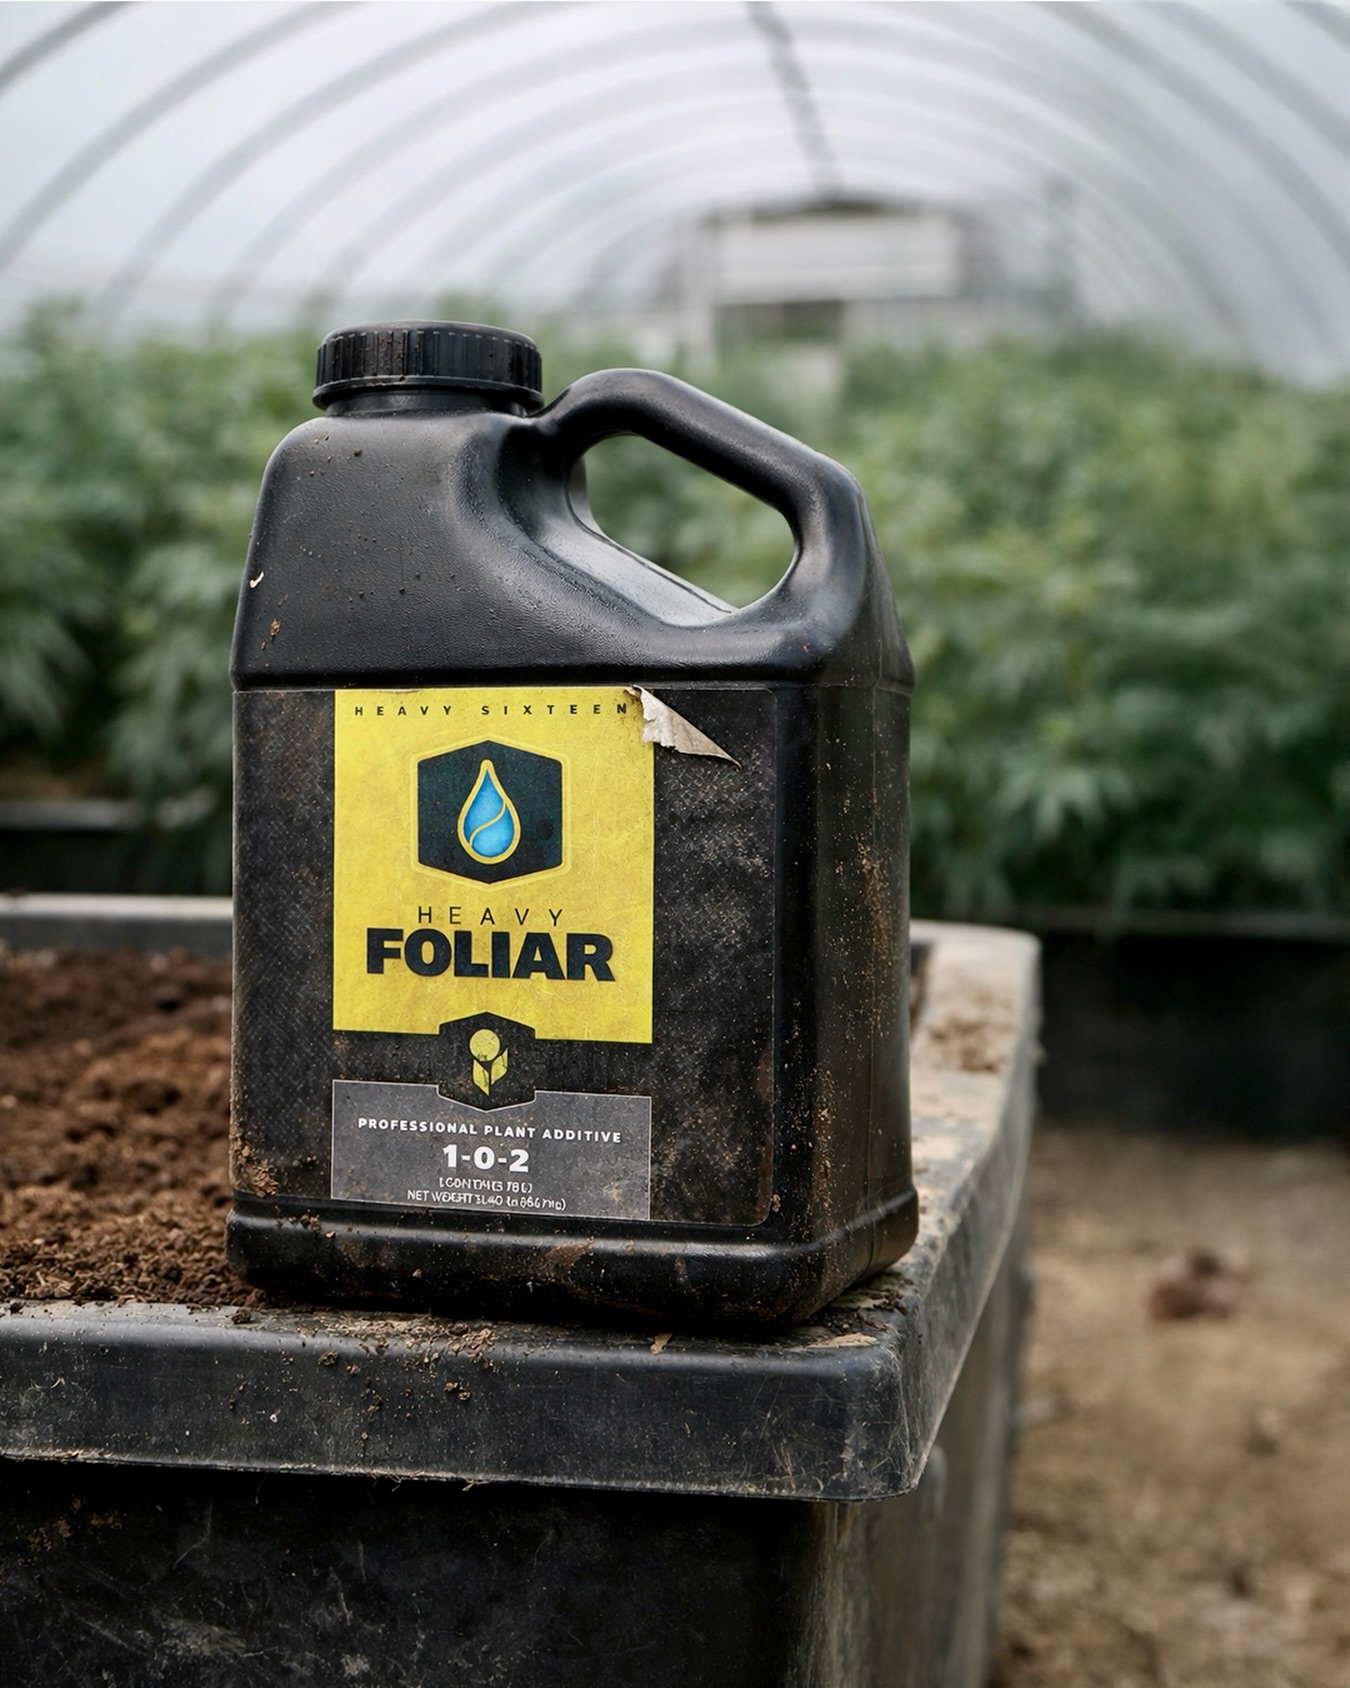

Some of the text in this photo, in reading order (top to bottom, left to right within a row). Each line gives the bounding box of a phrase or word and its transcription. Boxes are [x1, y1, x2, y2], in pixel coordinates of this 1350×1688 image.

[354, 703, 627, 717] HEAVY SIXTEEN
[418, 906, 563, 927] HEAVY
[366, 927, 616, 982] FOLIAR
[358, 1118, 622, 1143] PROFESSIONAL PLANT ADDITIVE
[443, 1144, 530, 1173] 1-0-2
[407, 1189, 429, 1202] NET
